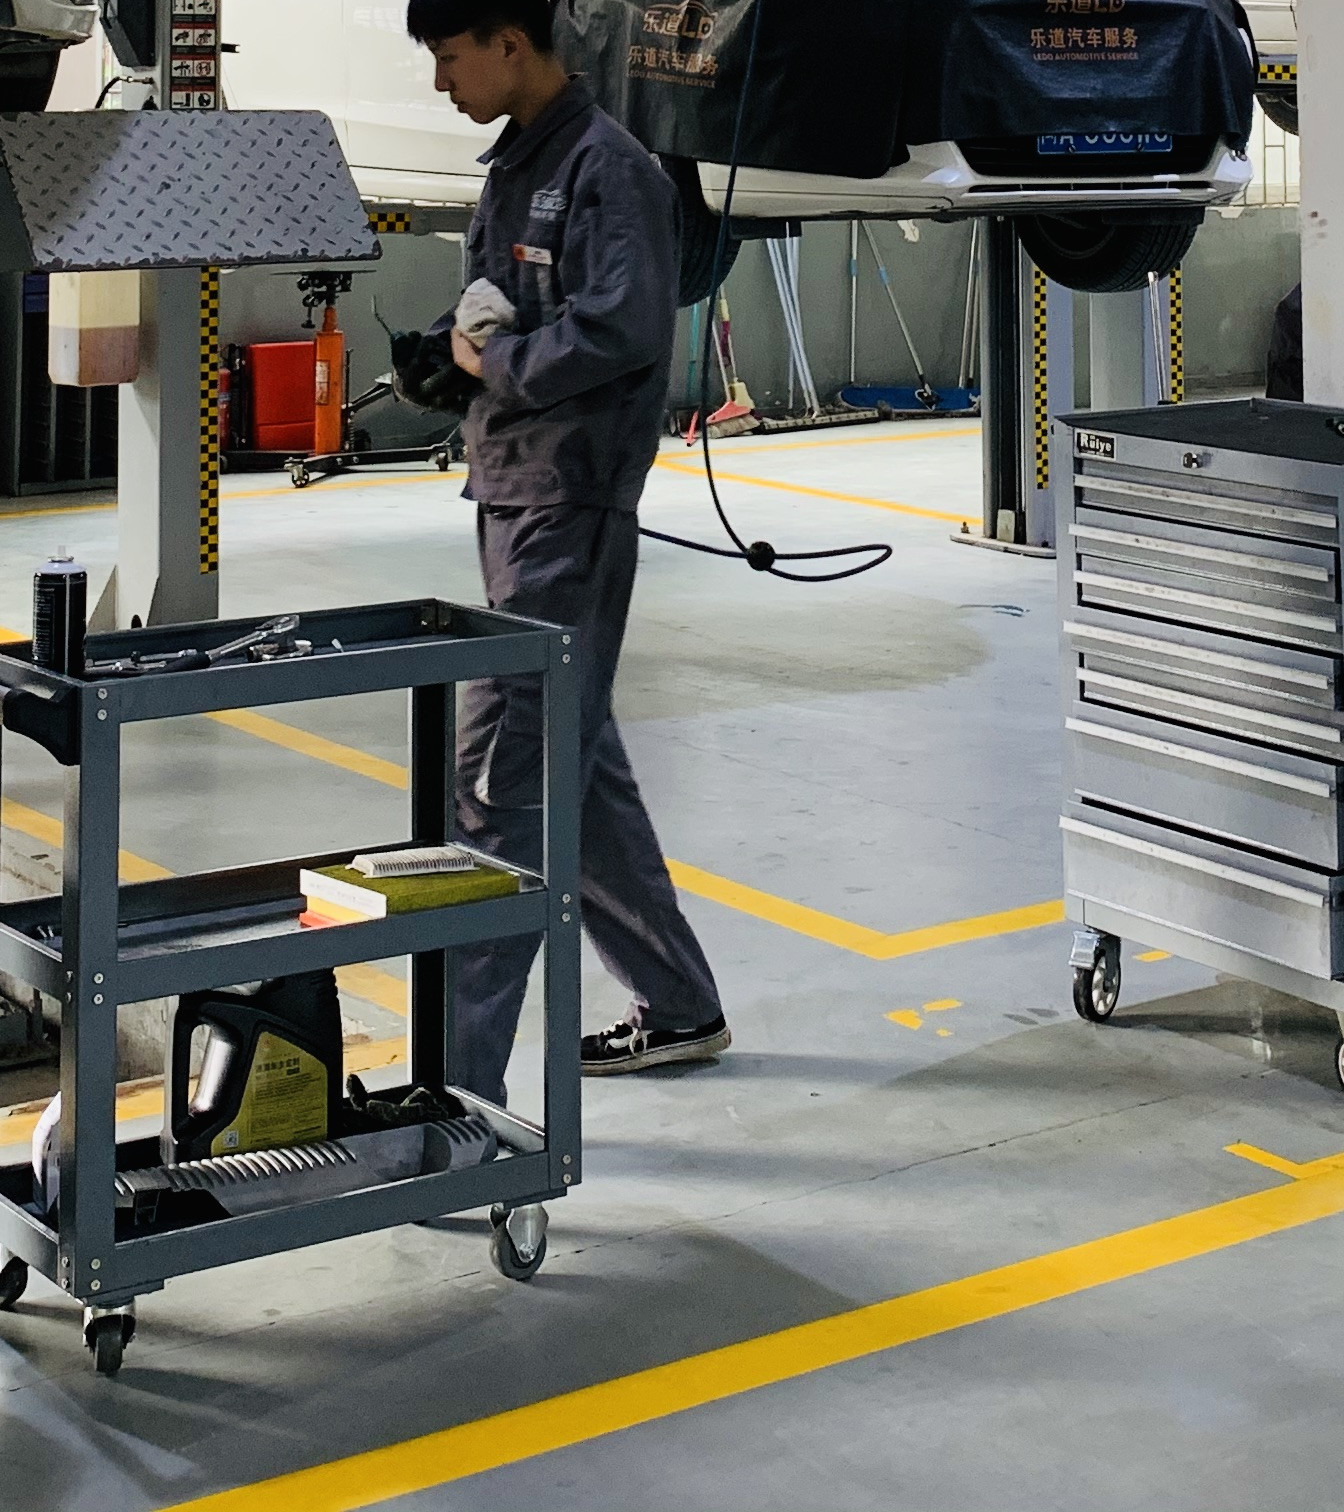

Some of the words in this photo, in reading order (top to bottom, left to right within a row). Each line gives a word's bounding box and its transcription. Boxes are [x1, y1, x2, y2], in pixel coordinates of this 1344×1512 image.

[643, 9, 715, 39] 乐道LD
[1030, 27, 1138, 48] 乐道汽车服务
[627, 45, 718, 75] 乐道汽车服务
